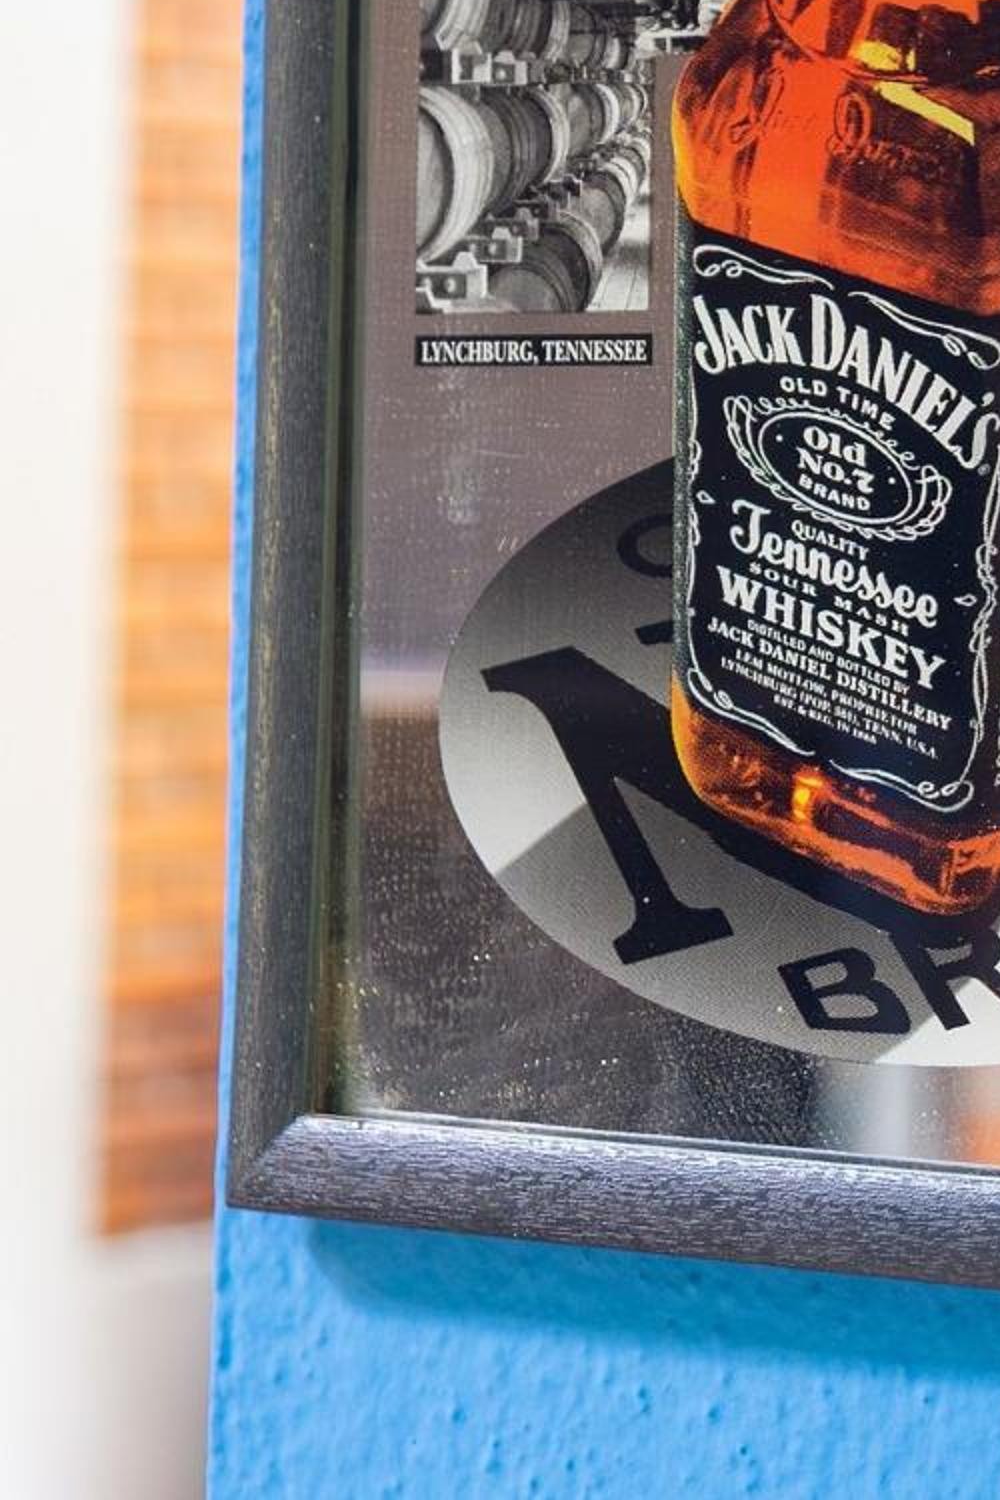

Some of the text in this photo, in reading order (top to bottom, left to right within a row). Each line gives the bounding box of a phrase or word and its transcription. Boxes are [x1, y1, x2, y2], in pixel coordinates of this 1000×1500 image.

[421, 339, 648, 365] LYNCHBURG, TENNESSEE
[694, 295, 806, 375] JACK
[779, 375, 896, 431] OLD TIME
[803, 425, 866, 468] Old
[798, 473, 871, 511] BRAND
[730, 499, 939, 628] Tennessee
[791, 519, 870, 561] QUALITY
[716, 564, 947, 690] WHISKEY
[750, 562, 909, 637] SOUR MASH
[747, 618, 807, 652] DISTILLED
[808, 644, 835, 662] AND
[707, 616, 952, 731] JACK DANIEL DISTILLERY
